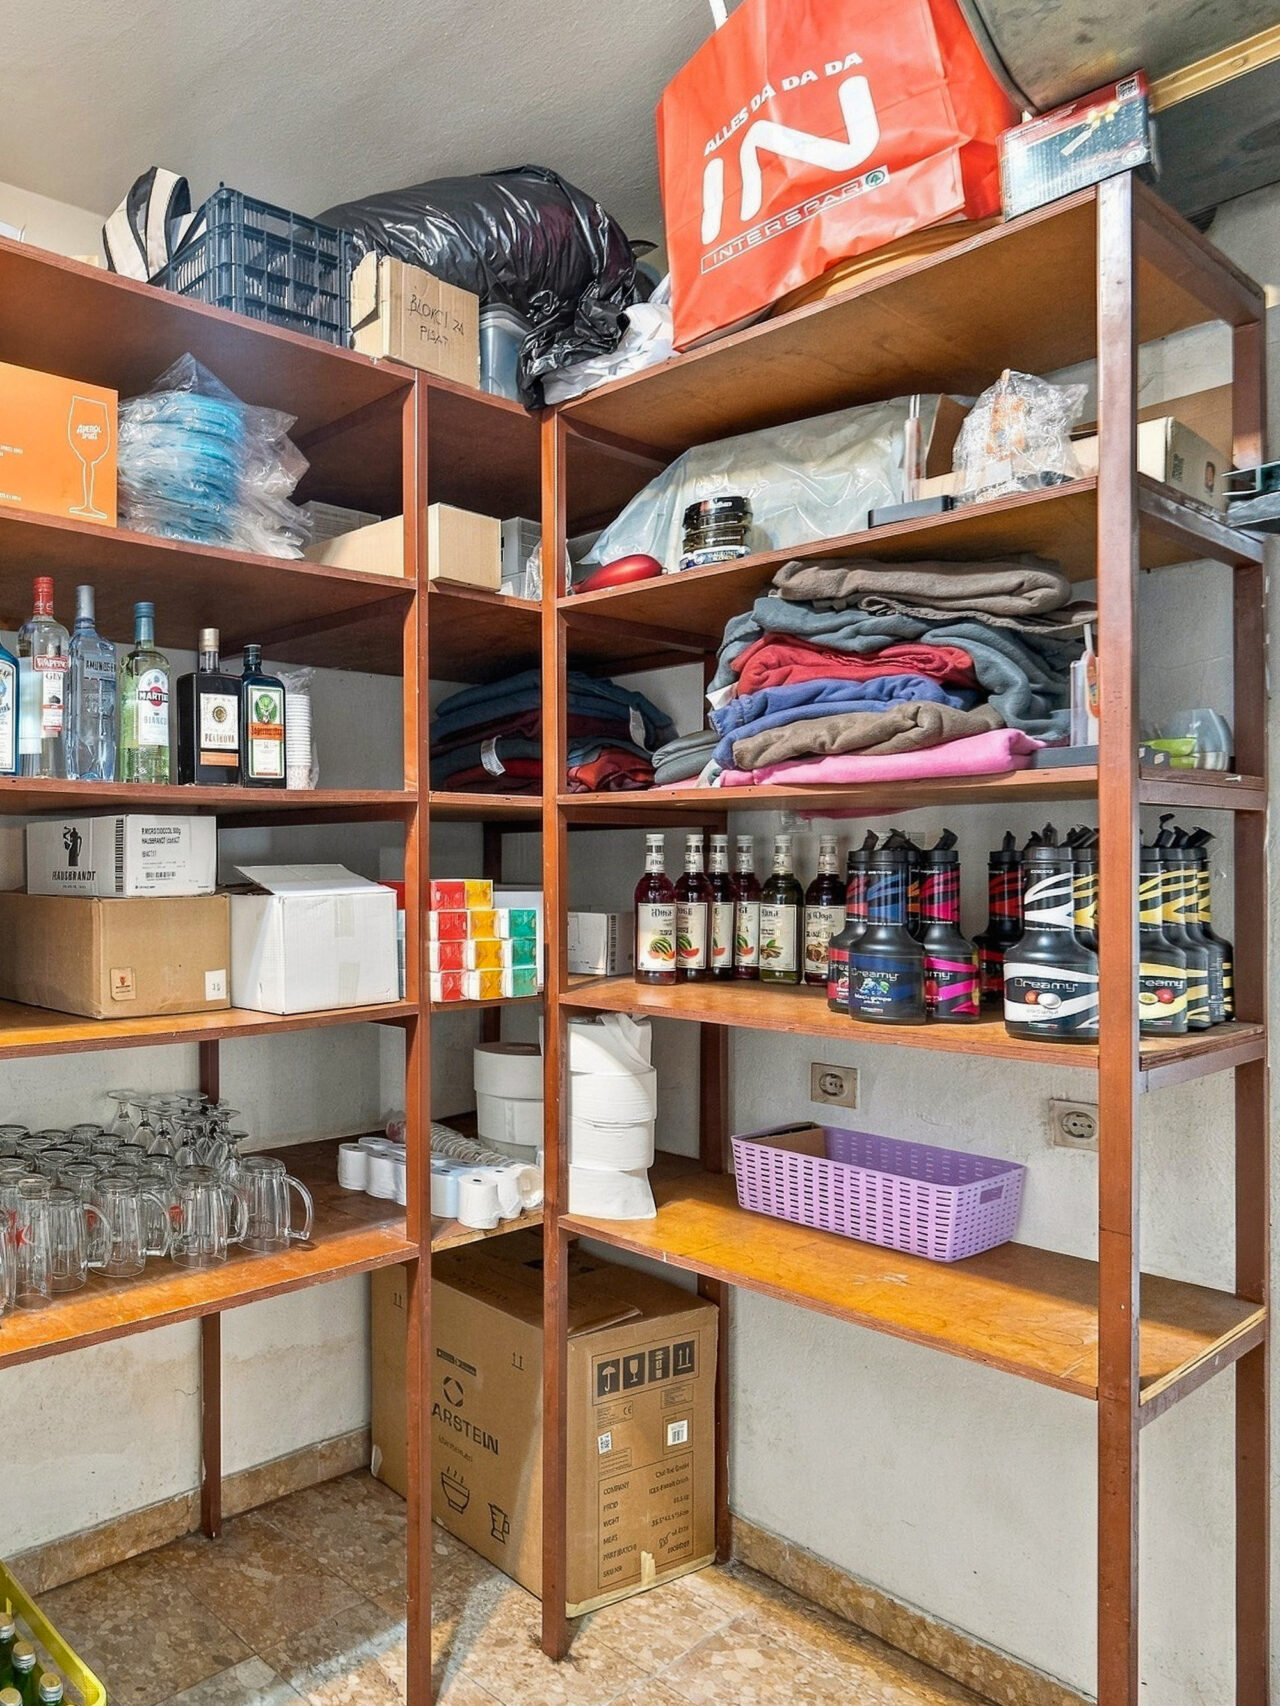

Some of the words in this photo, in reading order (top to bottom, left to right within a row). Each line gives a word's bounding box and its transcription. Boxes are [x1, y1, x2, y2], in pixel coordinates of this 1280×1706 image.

[704, 106, 749, 157] ALLES
[750, 82, 777, 112] DA
[781, 69, 819, 92] DA
[824, 52, 863, 77] DA
[700, 75, 880, 246] IN
[713, 178, 864, 265] INTERSPAR
[51, 870, 96, 881] HAUSBRANDT
[1139, 976, 1184, 993] reamy
[431, 1402, 499, 1456] ARSTEIN
[603, 1481, 630, 1496] COMPANY
